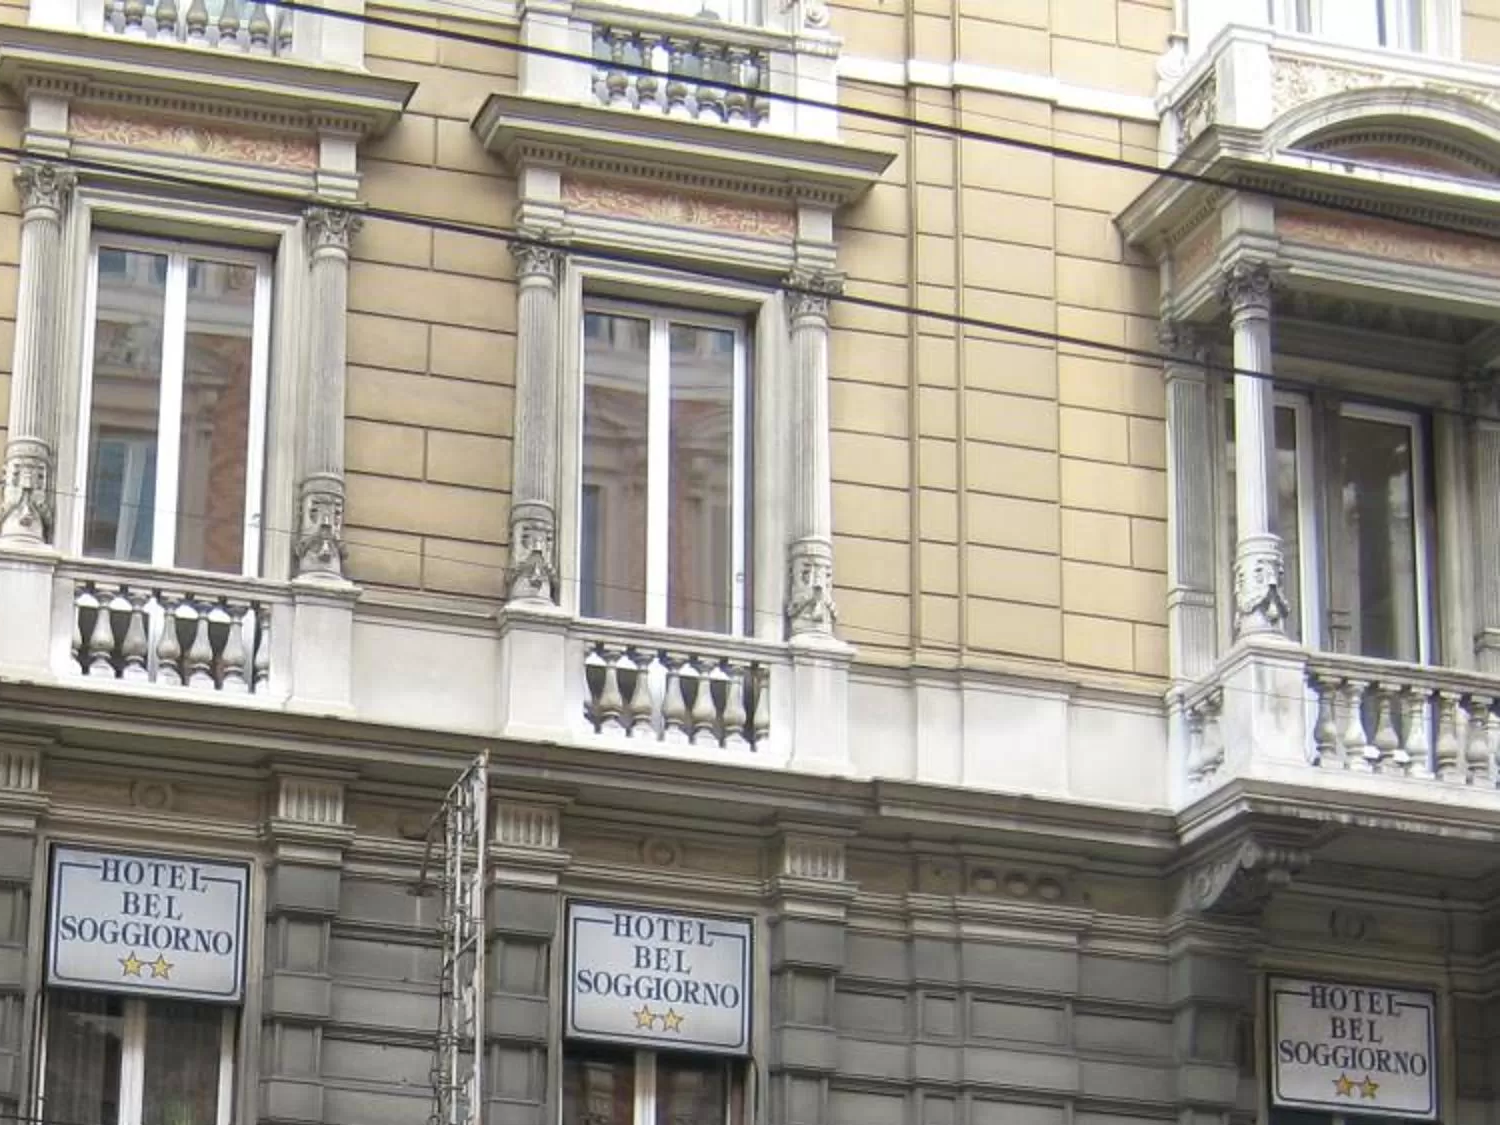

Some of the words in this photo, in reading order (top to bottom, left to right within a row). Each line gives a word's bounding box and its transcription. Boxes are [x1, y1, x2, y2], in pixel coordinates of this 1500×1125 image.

[101, 858, 208, 893] HOTEL
[121, 890, 183, 921] BEL
[60, 915, 233, 955] SOGGIORNO
[613, 913, 714, 947] HOTEL
[634, 945, 692, 975] BEL
[577, 969, 740, 1009] SOGGIORNO
[1309, 985, 1401, 1017] HOTEL
[1330, 1016, 1383, 1043] BEL
[1279, 1039, 1427, 1077] SOGGIORNO
